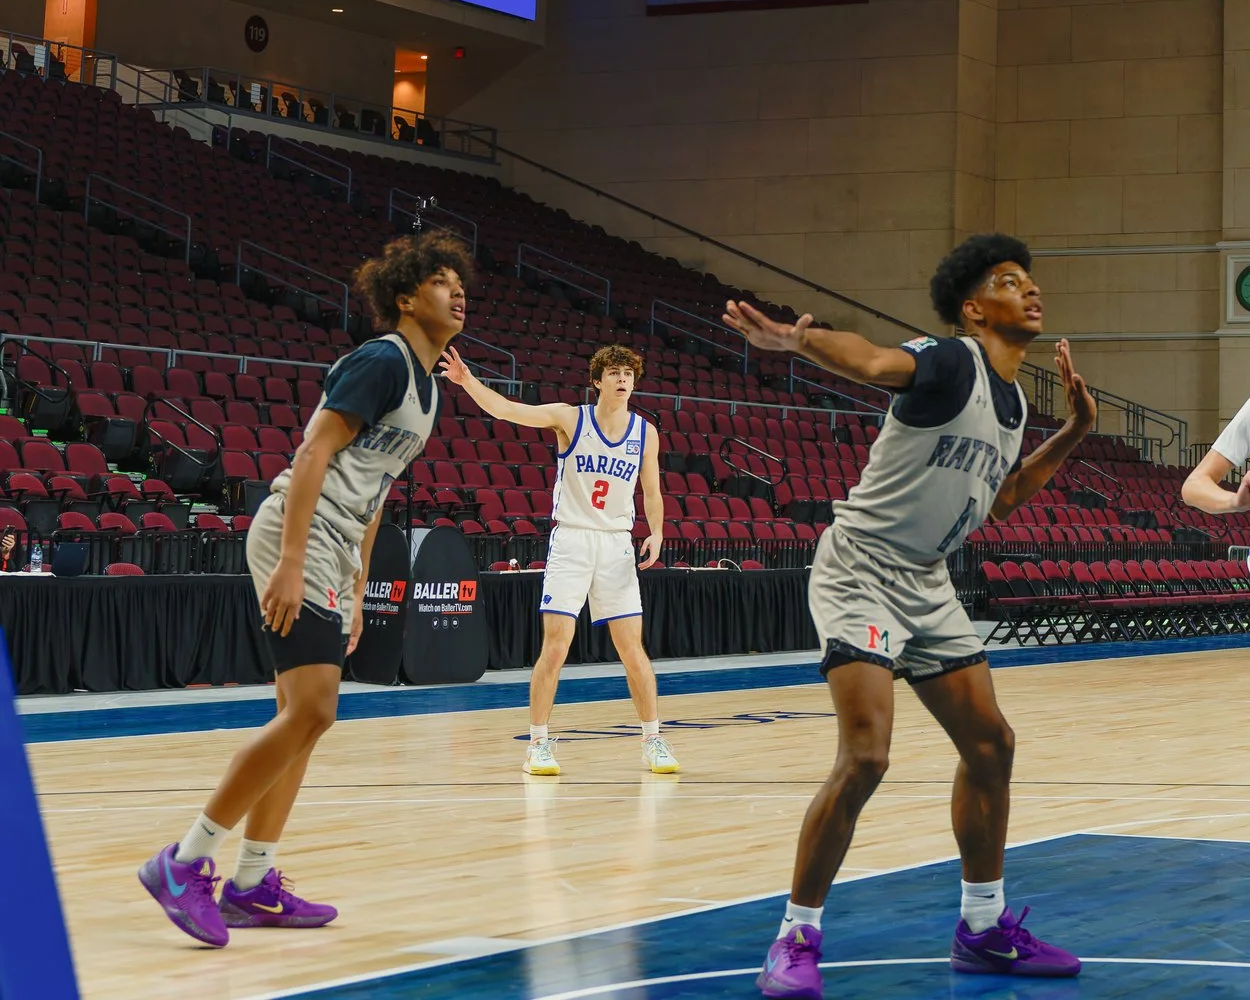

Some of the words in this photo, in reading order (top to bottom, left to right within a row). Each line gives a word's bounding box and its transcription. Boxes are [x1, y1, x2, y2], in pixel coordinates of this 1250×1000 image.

[249, 25, 266, 42] 119
[575, 454, 636, 482] PARISH
[591, 479, 609, 510] 2
[364, 581, 392, 598] ALLER
[393, 583, 402, 598] tv
[413, 582, 459, 599] BALLER
[462, 584, 474, 598] tv
[418, 603, 434, 612] Watch
[867, 624, 889, 652] M
